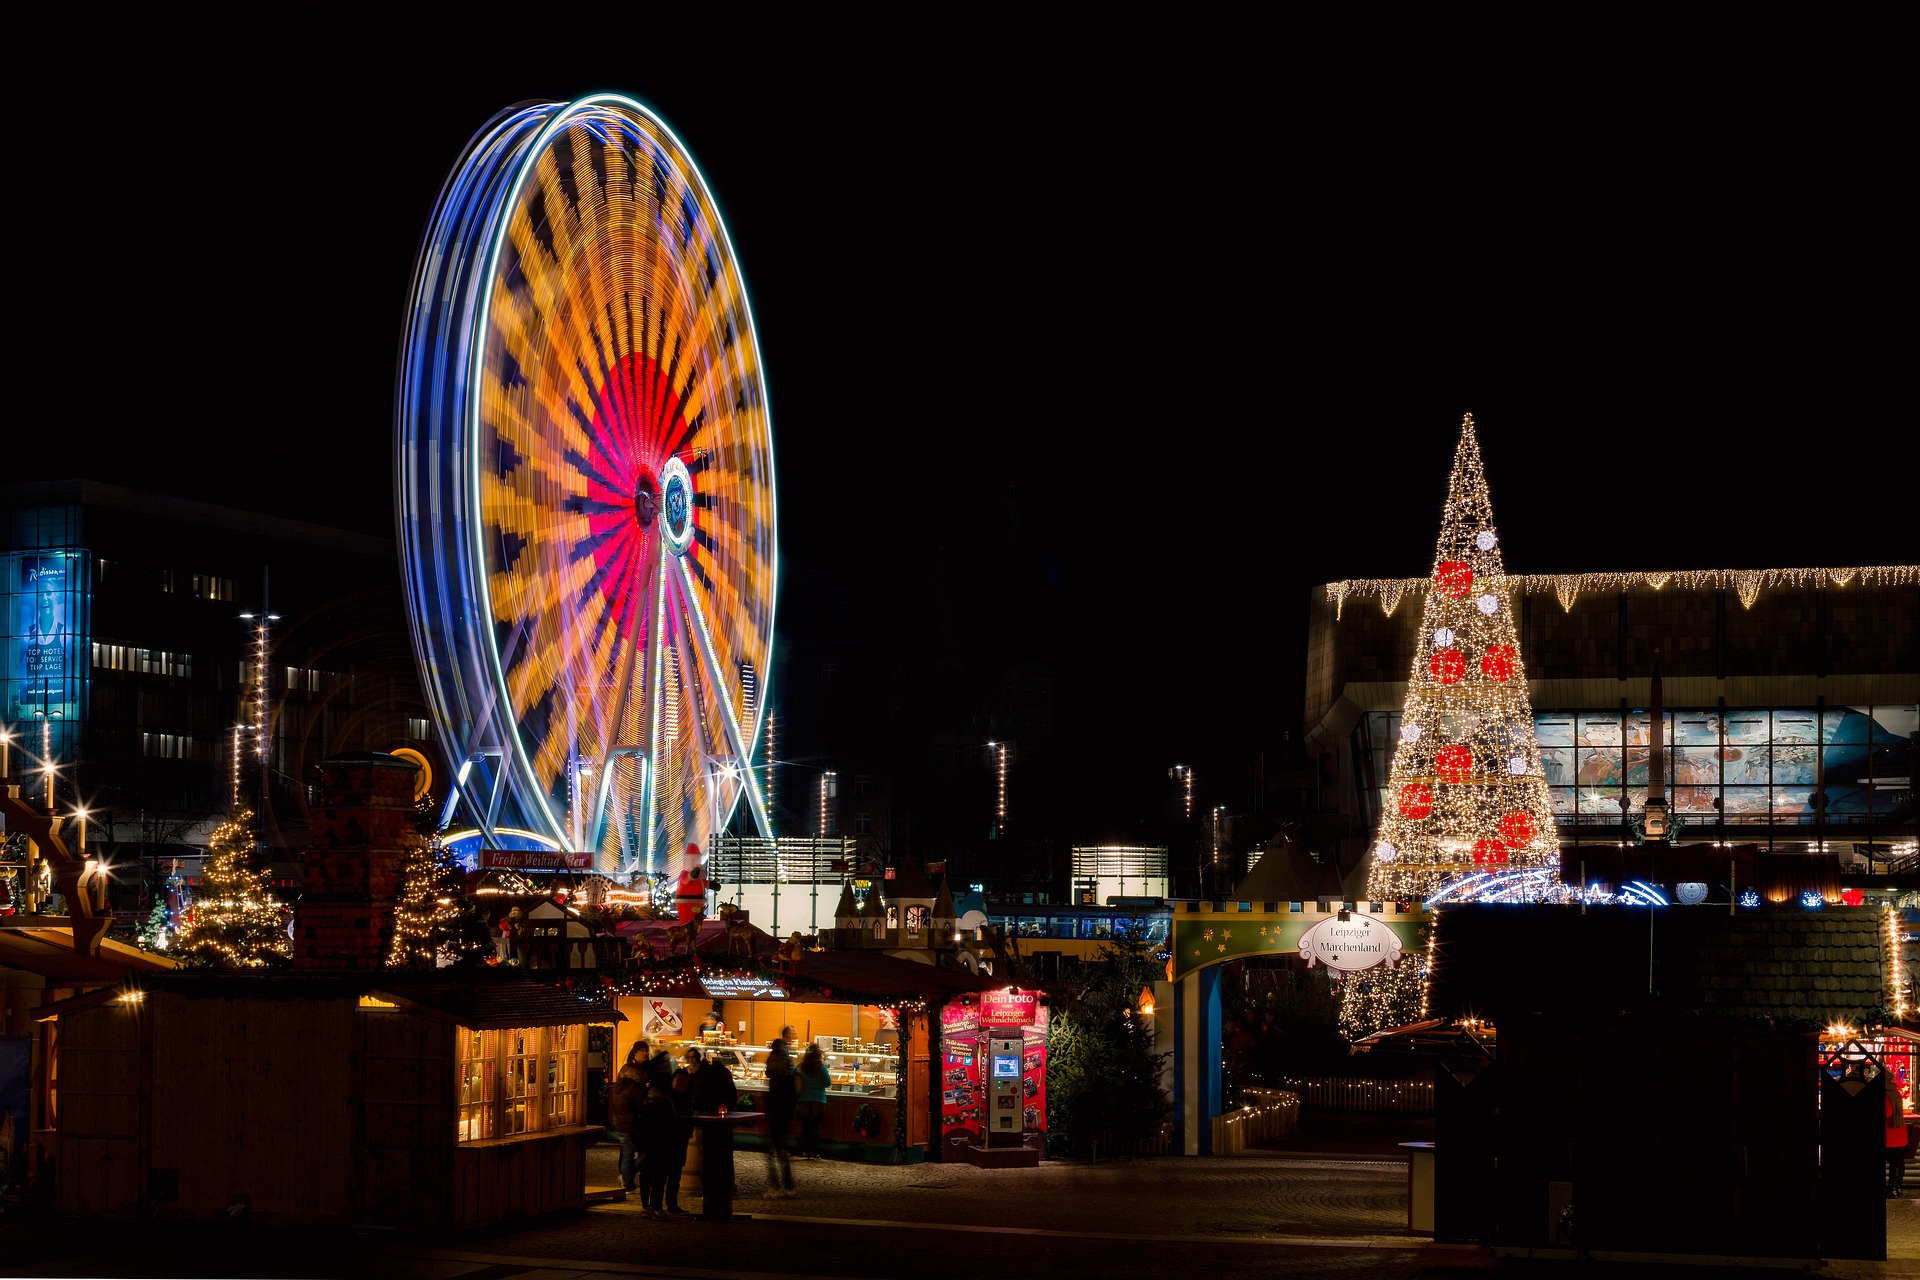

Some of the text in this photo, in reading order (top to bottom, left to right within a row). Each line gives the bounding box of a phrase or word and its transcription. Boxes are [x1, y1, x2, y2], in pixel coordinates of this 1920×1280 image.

[492, 852, 521, 865] Frohe
[1330, 927, 1372, 939] Leipziger
[1320, 942, 1381, 952] Märchenland
[984, 994, 1034, 1004] Dein Foto
[991, 1009, 1025, 1018] Leipziger
